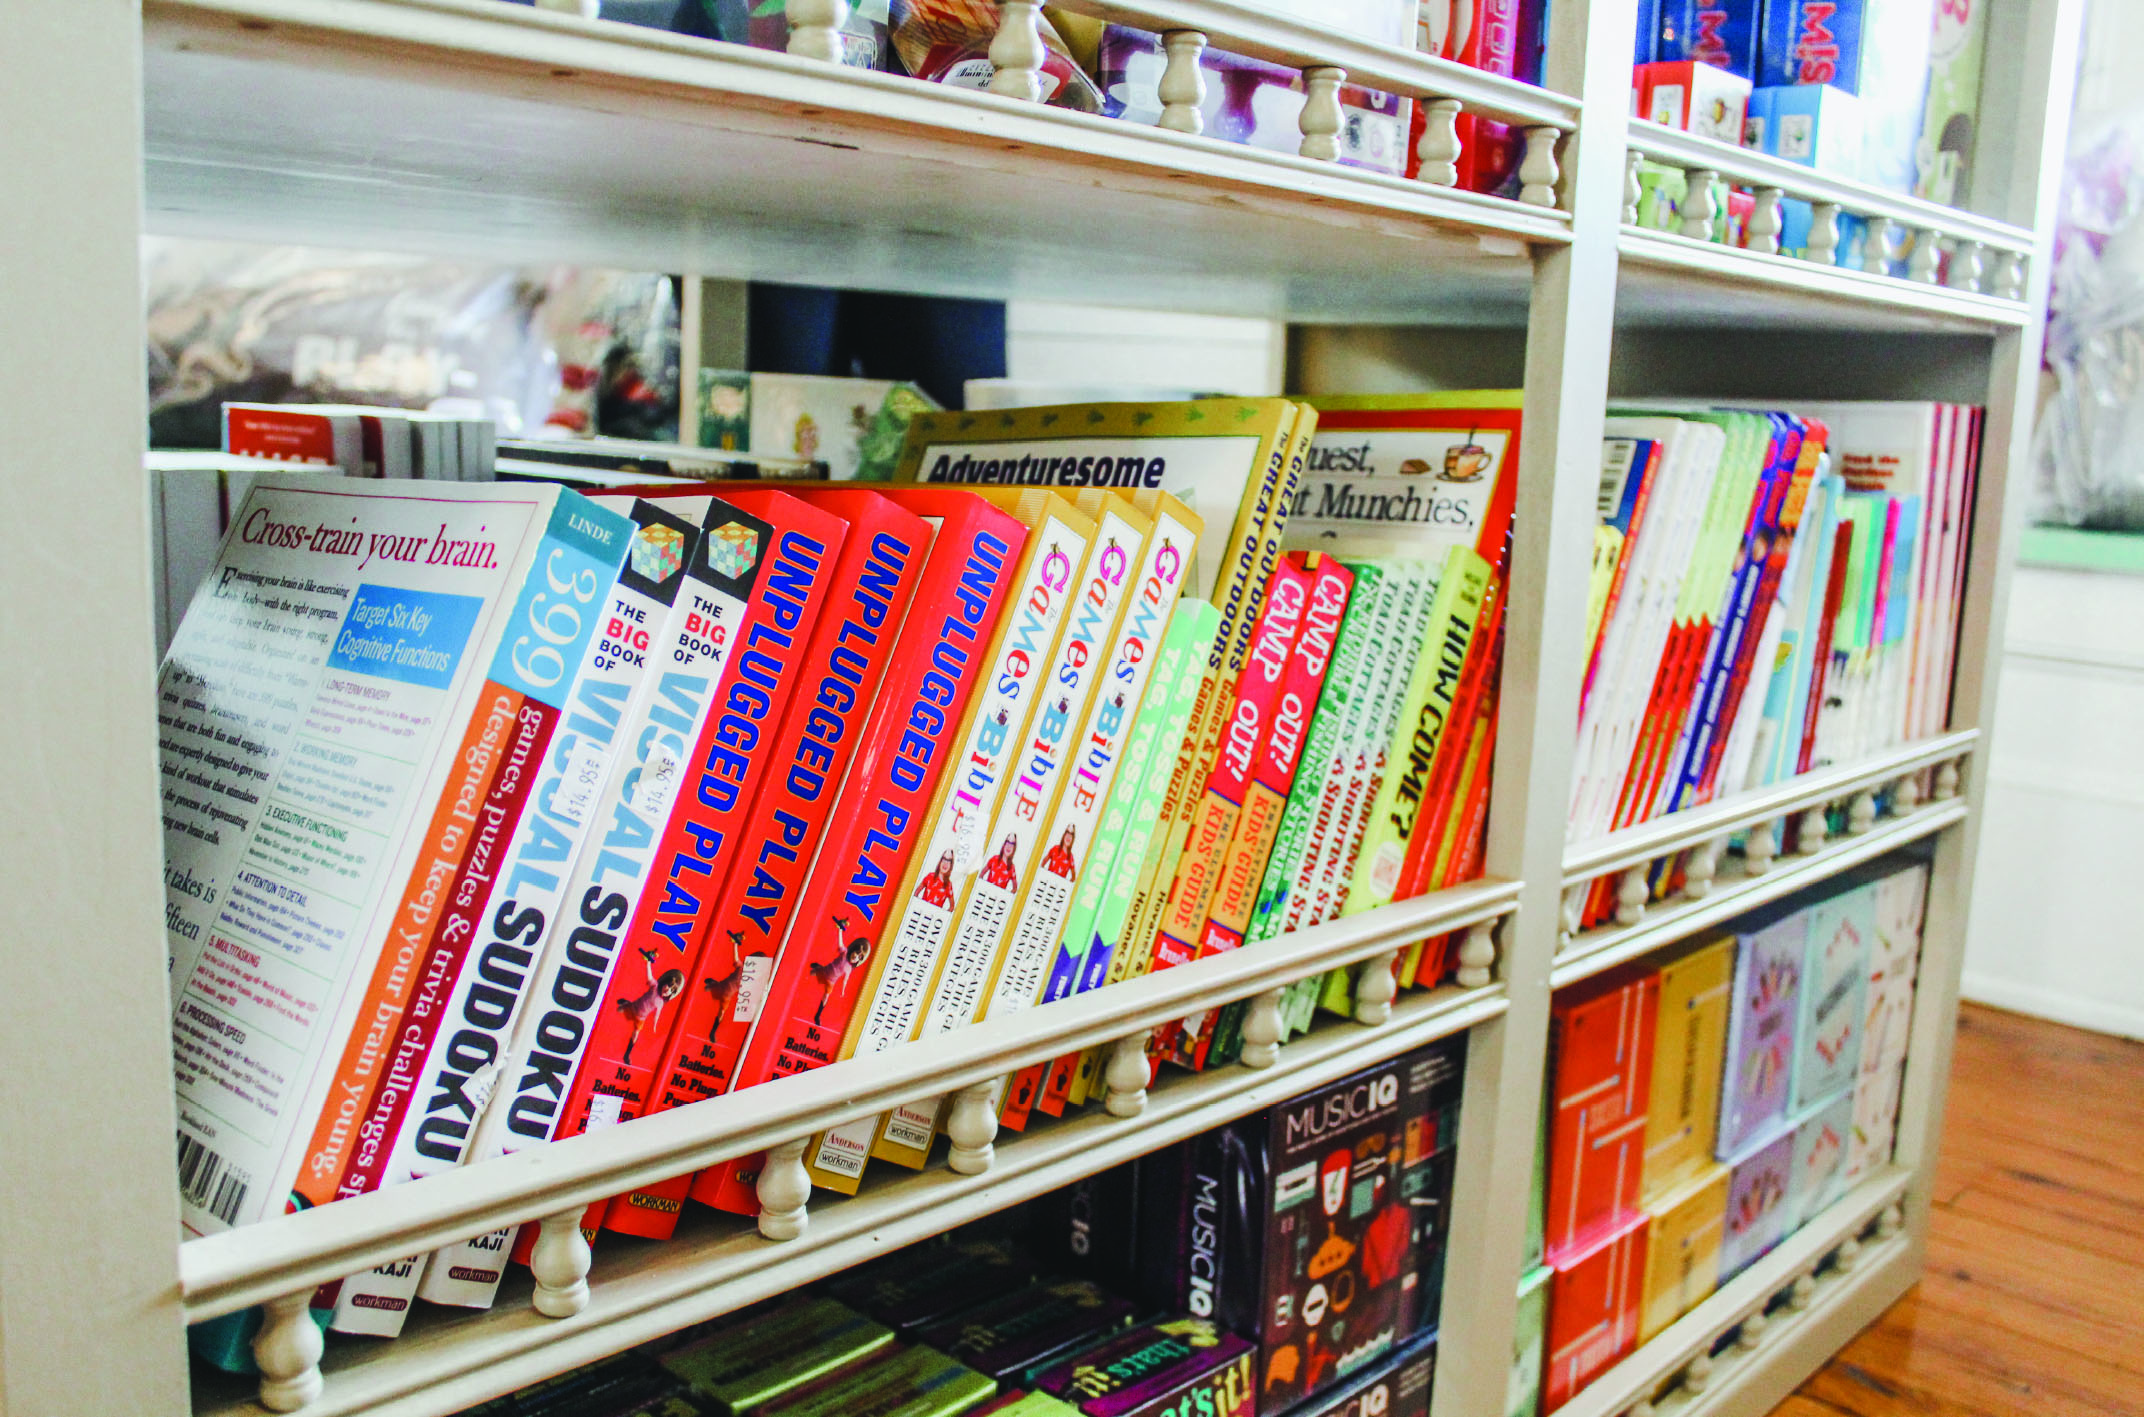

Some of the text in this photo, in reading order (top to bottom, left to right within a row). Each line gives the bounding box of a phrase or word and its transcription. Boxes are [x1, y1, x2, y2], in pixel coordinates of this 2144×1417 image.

[928, 454, 1166, 488] Adventuresome
[1307, 441, 1375, 478] uest,
[1314, 483, 1474, 532] Munchies,
[242, 507, 499, 570] Cross-train your brain.
[567, 512, 613, 545] LINDE
[1208, 451, 1285, 669] GREAT OUTDOORS
[1229, 456, 1305, 671] GREAT OUTDOORS
[280, 575, 297, 591] brain
[352, 597, 433, 637] Target Six Key
[511, 548, 598, 689] 399
[615, 600, 646, 624] THE
[693, 596, 722, 619] THE
[605, 617, 650, 651] BIG
[679, 634, 722, 662] BOOK
[684, 613, 727, 646] BIG
[337, 630, 451, 672] Cognitive Functions
[594, 656, 616, 672] OF
[599, 639, 646, 669] BOOK
[674, 649, 694, 665] OF
[1220, 576, 1307, 781] CAMP OUT!
[1264, 572, 1349, 772] CAMP OUT!
[650, 530, 827, 954] UNPLUGGED PLAY
[738, 530, 912, 938] UNPLUGGED PLAY
[844, 529, 1010, 924] UNPLUGGED PLAY
[1389, 614, 1473, 840] HOW COME?
[1115, 637, 1207, 899] TAG, TOSS & RUN
[1159, 676, 1217, 821] Games & Puzzles
[1178, 678, 1237, 822] Games & Puzzles
[1081, 644, 1180, 909] TAG, TOSS & RUN
[272, 807, 349, 843] EXECUTIVE FUNCTIONING
[1300, 780, 1339, 890] SHOOTING
[1324, 776, 1361, 882] SHOOTING
[1344, 773, 1382, 880] SHOOTING
[1174, 804, 1225, 928] KIDS' GUIDE
[1223, 794, 1269, 915] KIDS' GUIDE
[171, 867, 217, 904] takes is
[244, 873, 308, 907] ATTENTION TO DETAIL
[215, 937, 261, 968] MULTITASKING
[311, 695, 515, 1179] designed to keep your brain young.
[357, 705, 543, 1168] games, puzzles & trivia challenges
[938, 891, 985, 1012] THE STRATEGIES
[950, 895, 996, 1011] THE RULES, THE
[870, 910, 920, 1035] THE STRATEGIES
[883, 914, 932, 1033] THE RULES, THE
[894, 918, 943, 1040] OVER 300 GAMES
[960, 900, 1006, 1017] OVER 300 GAMES
[734, 959, 757, 1006] $16.95
[186, 1004, 247, 1046] PROCESSING SPEED
[806, 1027, 821, 1042] No
[678, 1055, 725, 1080] Batteries.
[701, 1045, 716, 1060] No
[777, 1055, 792, 1070] No
[784, 1037, 829, 1062] Batteries.
[591, 1079, 641, 1104] Batteries.
[615, 1067, 631, 1083] No
[670, 1073, 687, 1090] No
[829, 1134, 864, 1151] ANDERSON
[889, 1123, 926, 1145] workman
[821, 1154, 859, 1169] workman
[632, 1195, 679, 1213] WORKMAN
[451, 1268, 496, 1282] workman
[354, 1296, 406, 1310] workman
